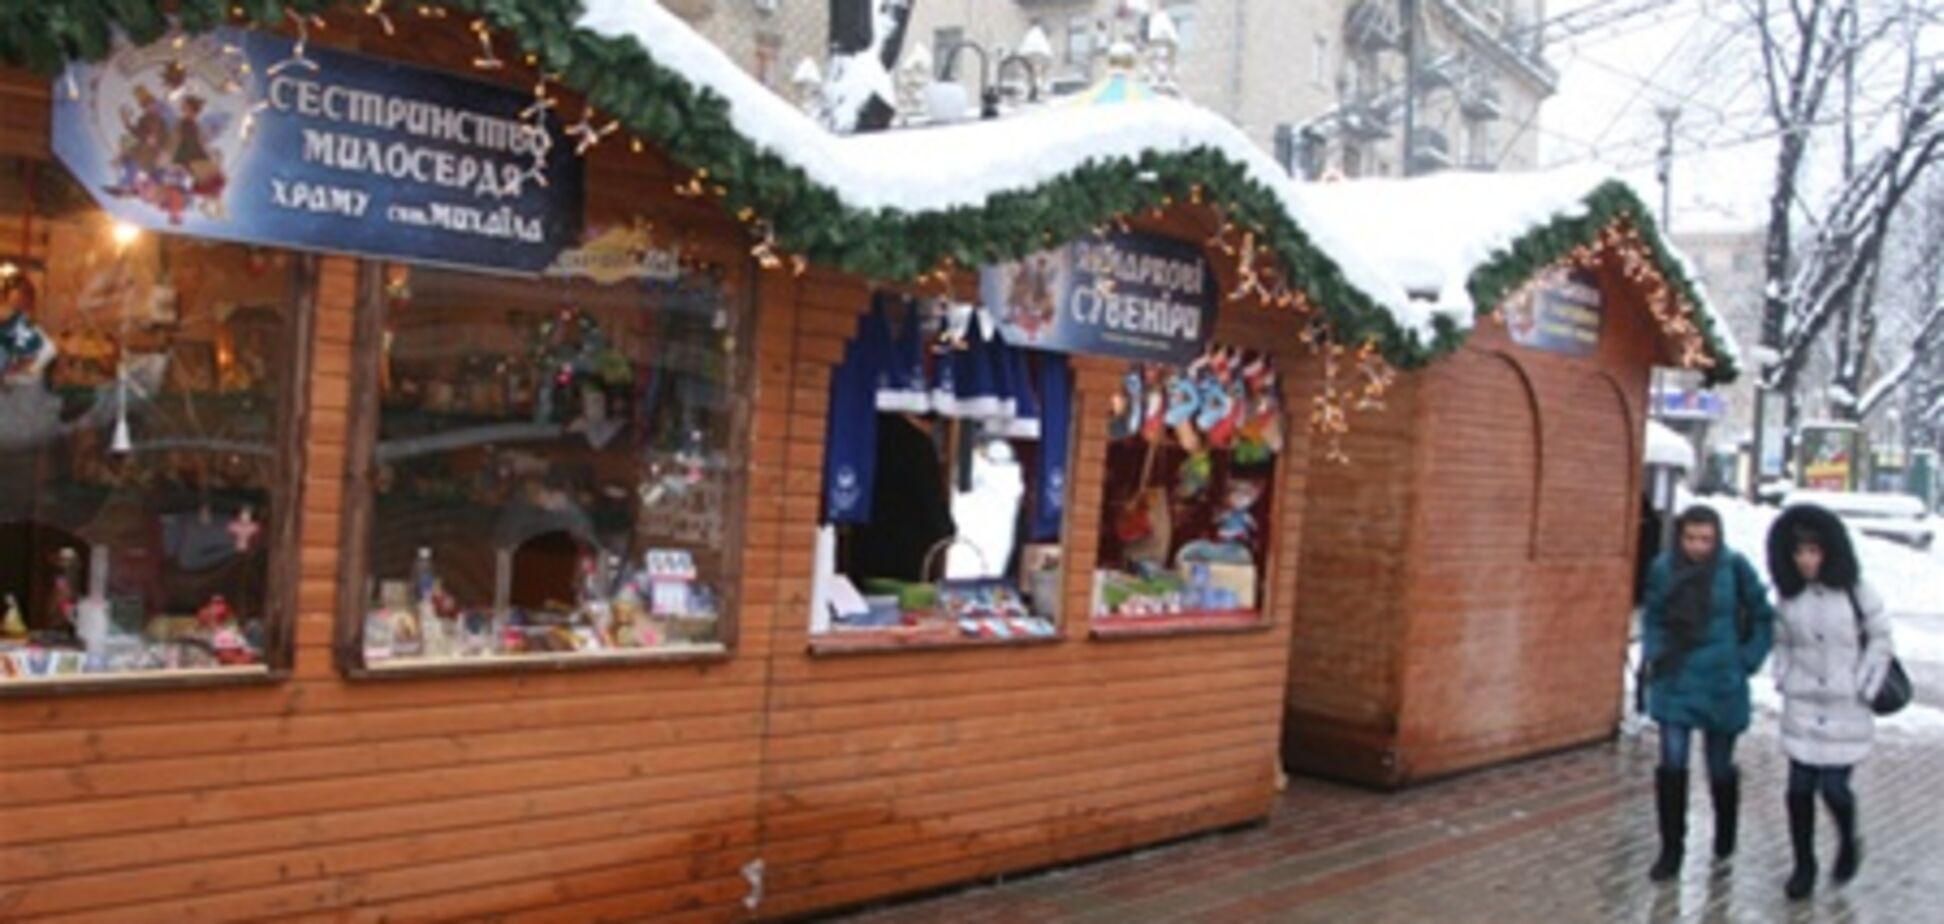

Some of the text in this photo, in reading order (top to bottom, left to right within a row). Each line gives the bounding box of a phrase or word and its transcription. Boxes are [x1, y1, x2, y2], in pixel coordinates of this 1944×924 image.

[269, 76, 552, 154] СЕСТРИНСТВО
[303, 129, 522, 197] МИЛОСЕРДЯ
[271, 179, 371, 216] ХРАМУ
[1071, 284, 1201, 340] СУВЕНІРИ
